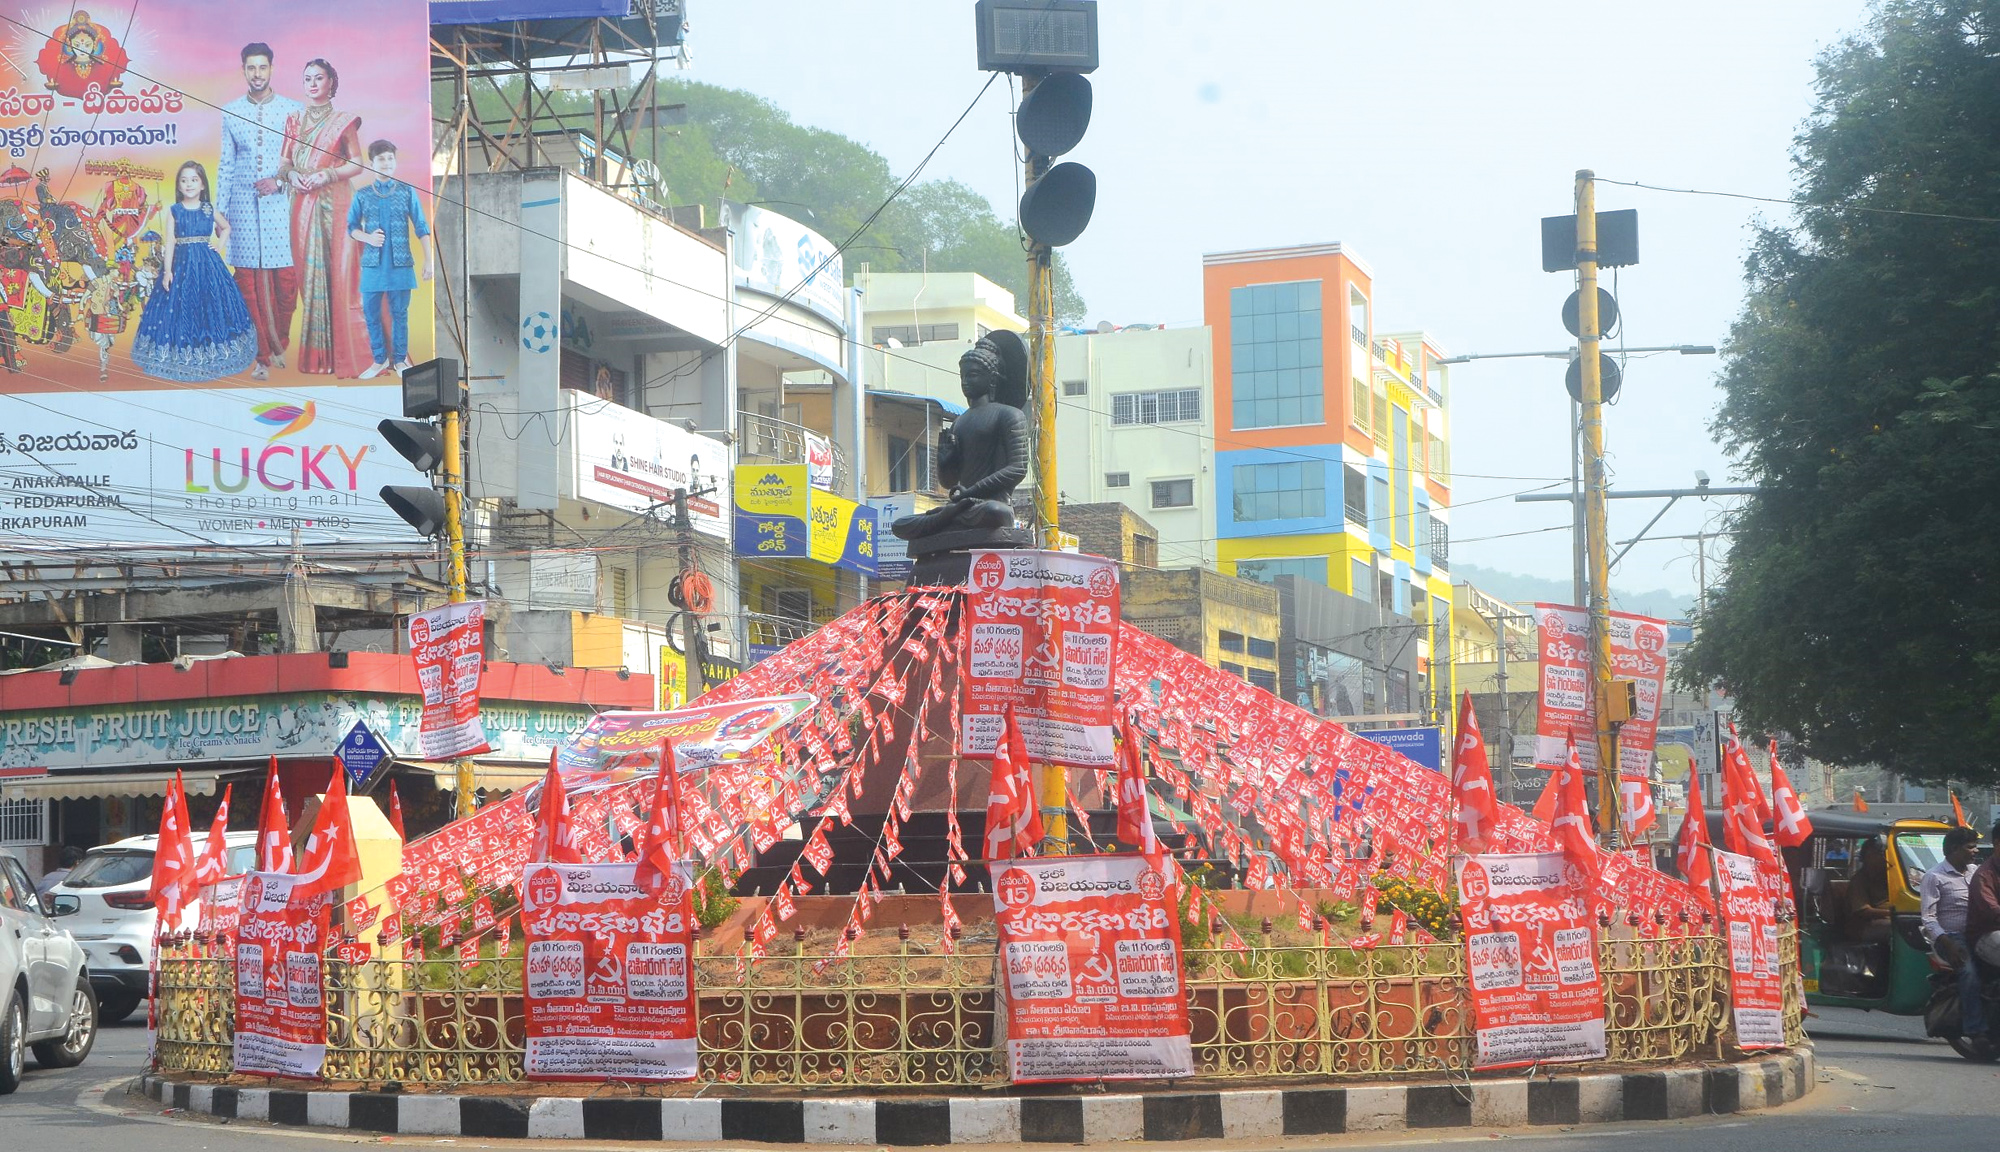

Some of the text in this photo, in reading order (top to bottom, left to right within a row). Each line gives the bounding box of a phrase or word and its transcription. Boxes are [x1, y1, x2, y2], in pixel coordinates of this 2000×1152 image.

[83, 82, 183, 114] దీపావళి
[50, 123, 177, 147] హంగామా!!
[17, 429, 138, 453] విజయవాడ
[185, 443, 369, 493] LUCKY
[630, 456, 687, 484] SHINE HAIR STUDIO
[12, 475, 111, 489] ANAKAPALLE
[14, 495, 121, 509] PEDDAPURAM
[185, 493, 358, 511] shopping mall
[0, 515, 88, 530] RKAPURAM
[198, 516, 350, 531] WOMEN MEN KIDS
[758, 521, 786, 538] గోల్డ్
[757, 539, 786, 552] లోన్
[858, 543, 873, 558] లోన్
[980, 572, 999, 588] 15
[1009, 567, 1084, 585] విజయవాడ
[1072, 599, 1112, 632] భేరి
[414, 630, 429, 643] 15
[987, 626, 994, 634] 10
[974, 638, 993, 654] మహా
[0, 703, 261, 748] RESH FRUIT JUICE
[536, 710, 589, 735] JUICE
[179, 732, 261, 749] Ice & Snacks
[523, 735, 533, 744] Ice
[1371, 732, 1424, 743] vijayawada
[567, 870, 592, 881] ఛలో
[1039, 869, 1065, 881] ఛలో
[1491, 873, 1560, 886] విజయవాడ
[1040, 879, 1133, 893] విజయవాడ
[1466, 880, 1487, 898] 15
[536, 887, 557, 905] 15
[1005, 887, 1029, 905] 15
[531, 907, 684, 948] ప్రజారక్షణ భేరి
[1003, 903, 1169, 945] ప్రజారక్షణ భేరి
[542, 943, 550, 951] 10
[1021, 943, 1030, 952] 10
[1132, 942, 1139, 952] 11
[1480, 936, 1488, 944] 10
[642, 946, 649, 954] 11
[1472, 947, 1490, 967] మహా
[530, 955, 582, 979] మహా ప్రదర్శన
[628, 957, 684, 979] బహిరంగ సభ
[1010, 954, 1067, 980] మహా ప్రదర్శన
[1119, 952, 1175, 974] బహిరంగ సభ
